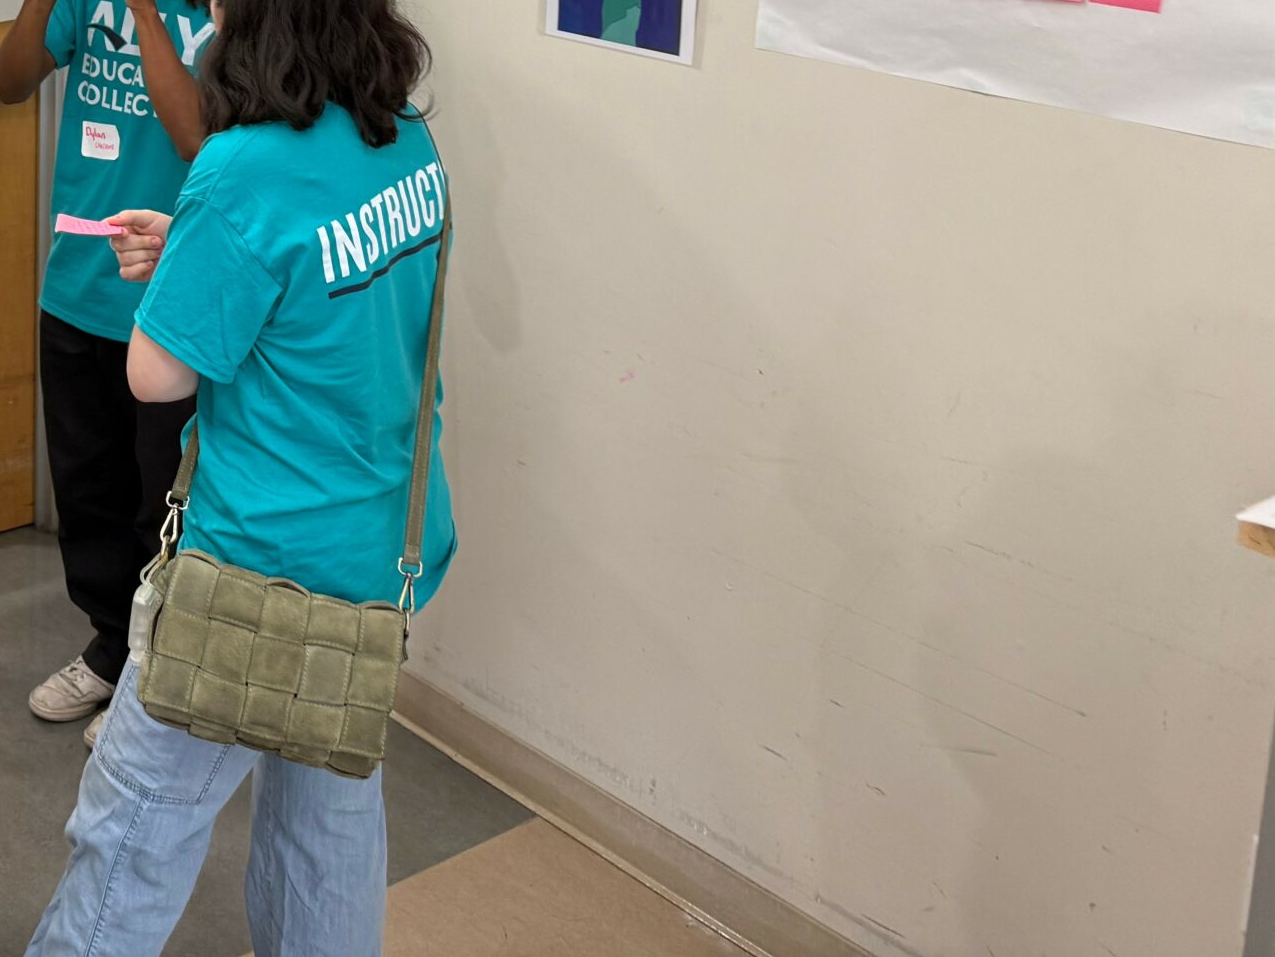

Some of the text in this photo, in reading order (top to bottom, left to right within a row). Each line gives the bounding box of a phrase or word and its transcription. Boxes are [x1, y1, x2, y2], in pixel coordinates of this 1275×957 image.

[87, 0, 216, 66] ALY
[81, 52, 145, 88] EDUCA
[77, 80, 159, 118] COLLEC
[316, 160, 446, 284] INSTRUCT
